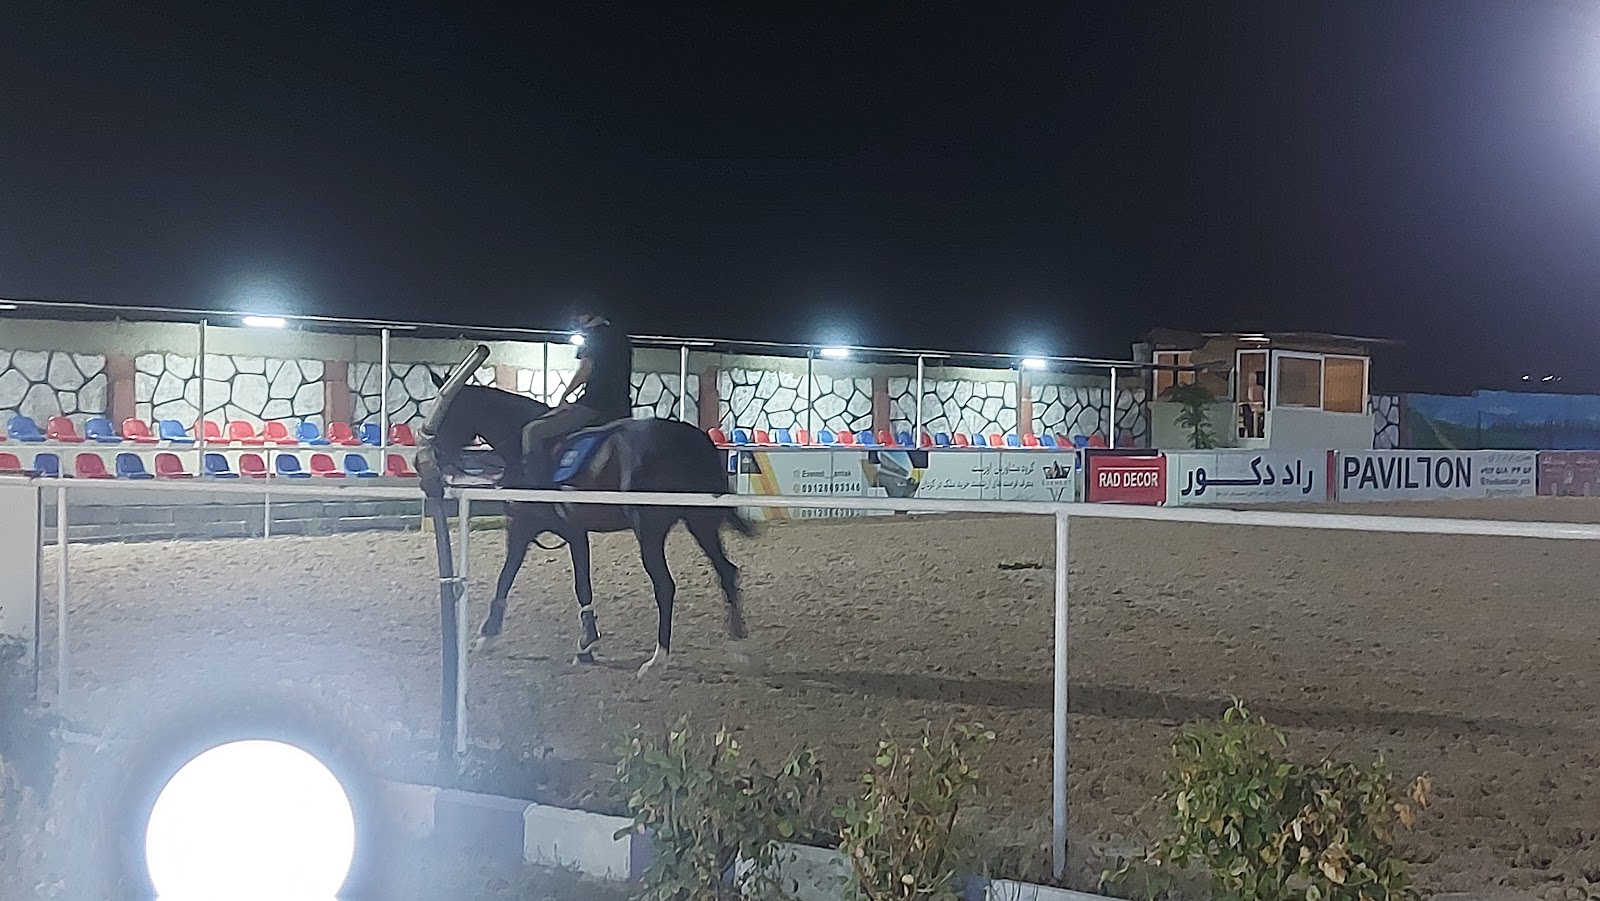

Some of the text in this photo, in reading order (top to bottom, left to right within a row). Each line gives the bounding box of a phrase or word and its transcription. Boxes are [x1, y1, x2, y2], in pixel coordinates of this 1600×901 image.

[1099, 471, 1159, 487] RAD DECOR
[1281, 458, 1314, 495] راد
